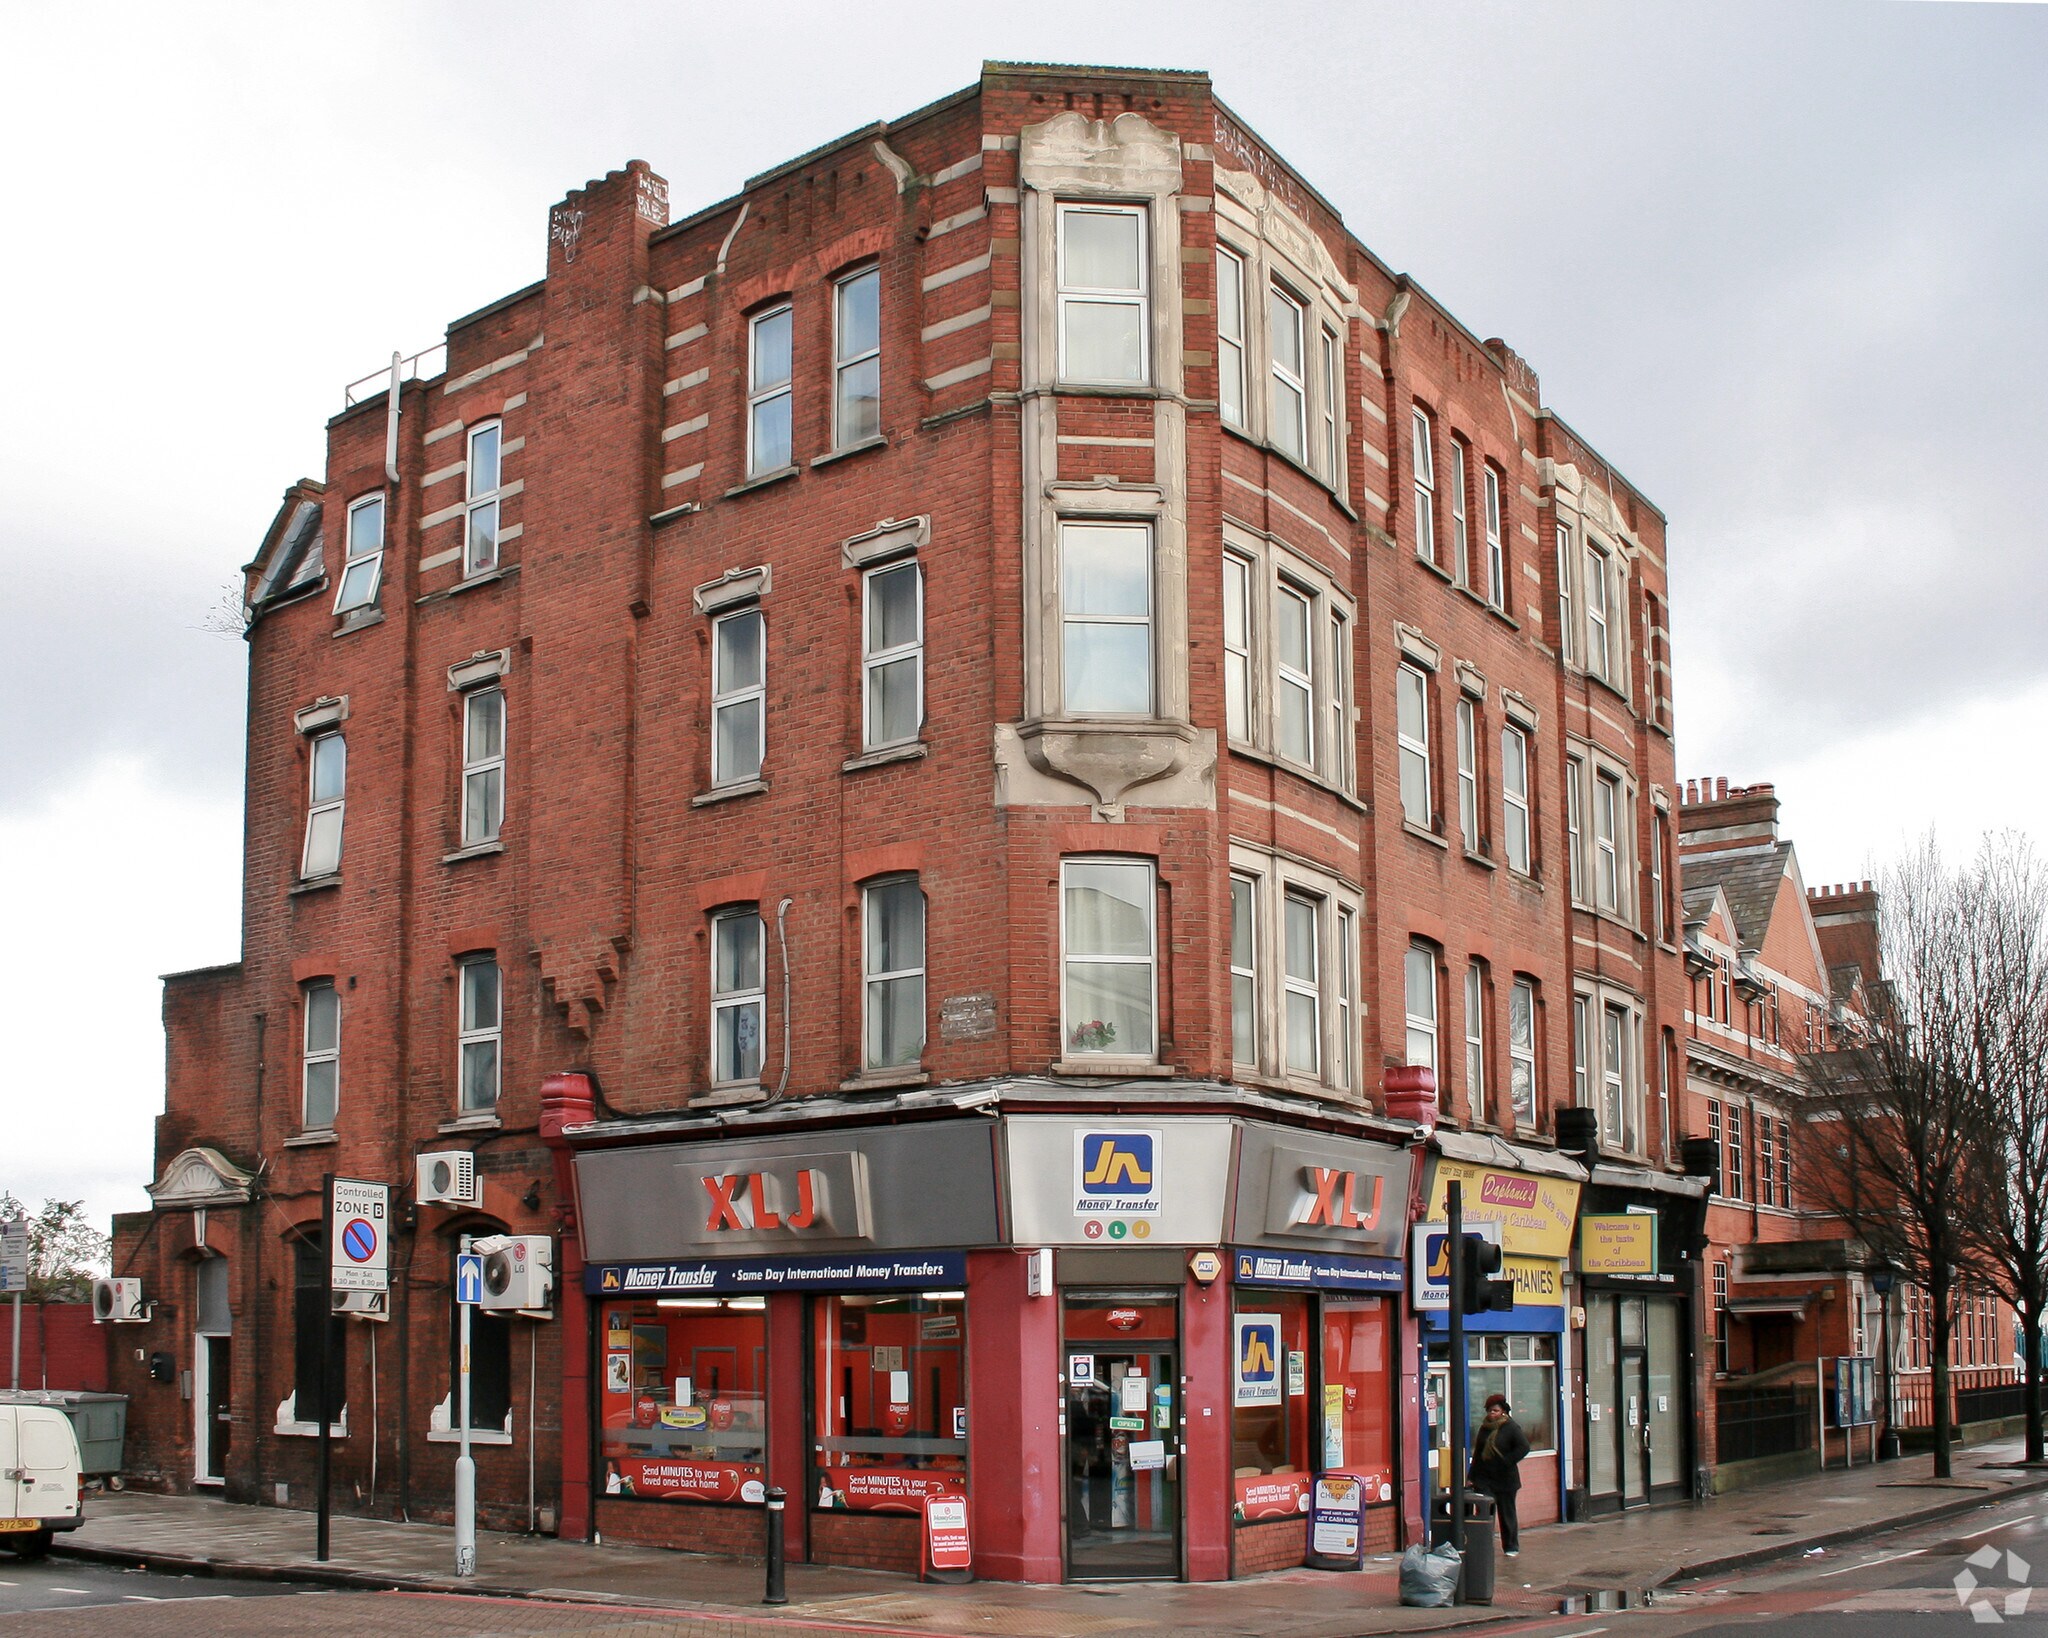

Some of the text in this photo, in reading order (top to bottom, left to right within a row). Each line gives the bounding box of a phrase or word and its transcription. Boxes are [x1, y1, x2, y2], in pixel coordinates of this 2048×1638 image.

[336, 1185, 384, 1199] Controlled
[1484, 1175, 1535, 1202] Daphanie's
[700, 1169, 815, 1232] XLJ
[1076, 1198, 1159, 1211] Money Transfer
[1307, 1167, 1385, 1231] XLJ
[336, 1201, 383, 1217] ZONE B
[1510, 1212, 1547, 1230] Caribbean
[1594, 1223, 1629, 1231] Welcome
[1613, 1247, 1621, 1255] of
[514, 1265, 525, 1273] LG
[1199, 1262, 1213, 1271] ADT
[1255, 1258, 1313, 1278] Money Transfer
[1604, 1259, 1646, 1267] Caribbean
[624, 1264, 718, 1290] Money Transfer
[736, 1261, 944, 1283] Same Day International Money Transfers
[1330, 1268, 1339, 1278] Day
[1340, 1269, 1368, 1278] International
[1368, 1271, 1382, 1281] Money
[1382, 1271, 1401, 1281] Transfers
[1112, 1310, 1137, 1319] Digicel
[1237, 1385, 1279, 1398] Money Transfer
[638, 1401, 655, 1410] Digicel
[713, 1403, 731, 1412] Digicel
[889, 1404, 910, 1413] Digicel
[642, 1464, 720, 1479] Send MINUTES to your
[642, 1476, 719, 1489] loved ones back home
[849, 1474, 927, 1489] Send MINUTES to your
[1321, 1483, 1356, 1491] WE CASH
[849, 1485, 927, 1497] loved ones back home
[1245, 1488, 1257, 1496] Send
[1257, 1485, 1277, 1495] MINUTES
[1281, 1485, 1291, 1495] your
[1320, 1492, 1356, 1501] CHEQUES
[1246, 1495, 1258, 1504] loved
[1258, 1495, 1269, 1503] ones
[1279, 1492, 1291, 1501] home
[933, 1514, 963, 1523] MoneyGram
